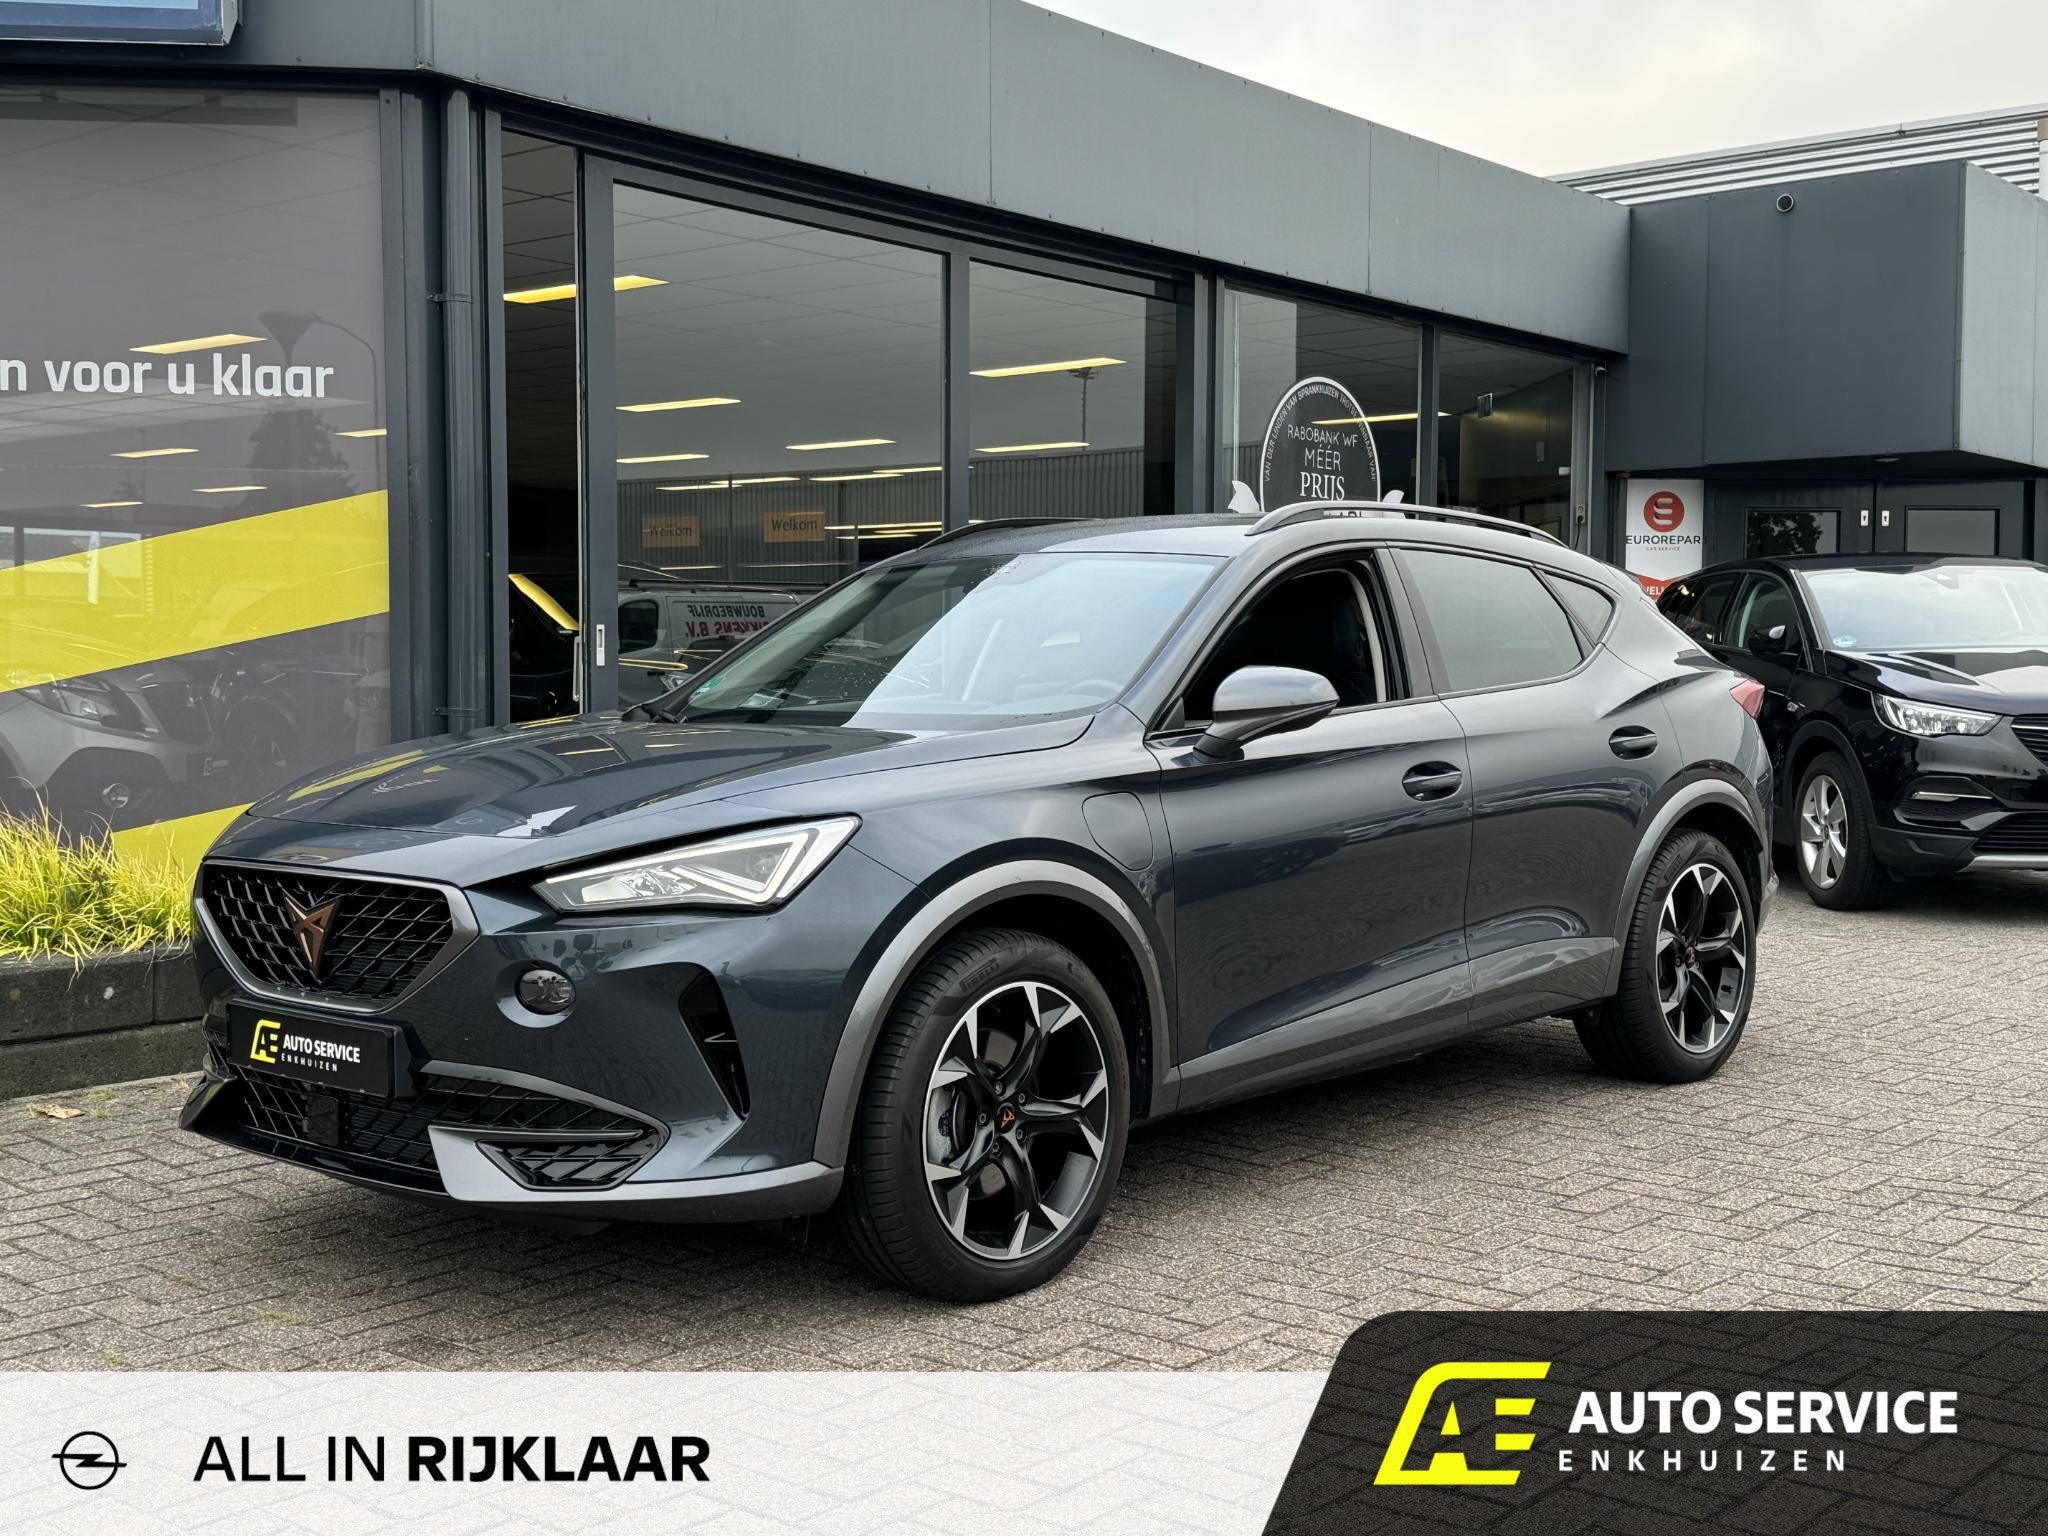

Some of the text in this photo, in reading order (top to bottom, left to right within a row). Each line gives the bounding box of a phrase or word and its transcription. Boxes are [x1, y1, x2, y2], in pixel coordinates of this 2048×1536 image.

[44, 360, 152, 394] voor
[167, 362, 195, 395] u
[212, 352, 335, 398] klaar
[1285, 395, 1299, 412] VAN
[1271, 409, 1288, 439] LINDEN
[1287, 424, 1359, 448] RABOBANK WF
[1266, 439, 1277, 460] DER
[1304, 444, 1342, 471] MÉÉR
[1264, 462, 1272, 482] VAN
[1300, 471, 1346, 501] PRIJS
[771, 517, 818, 532] Welkom
[1626, 534, 1702, 546] EUROREPAR
[283, 1034, 361, 1063] AUTO SERVICE
[281, 1053, 338, 1072] ENKHUIZEN
